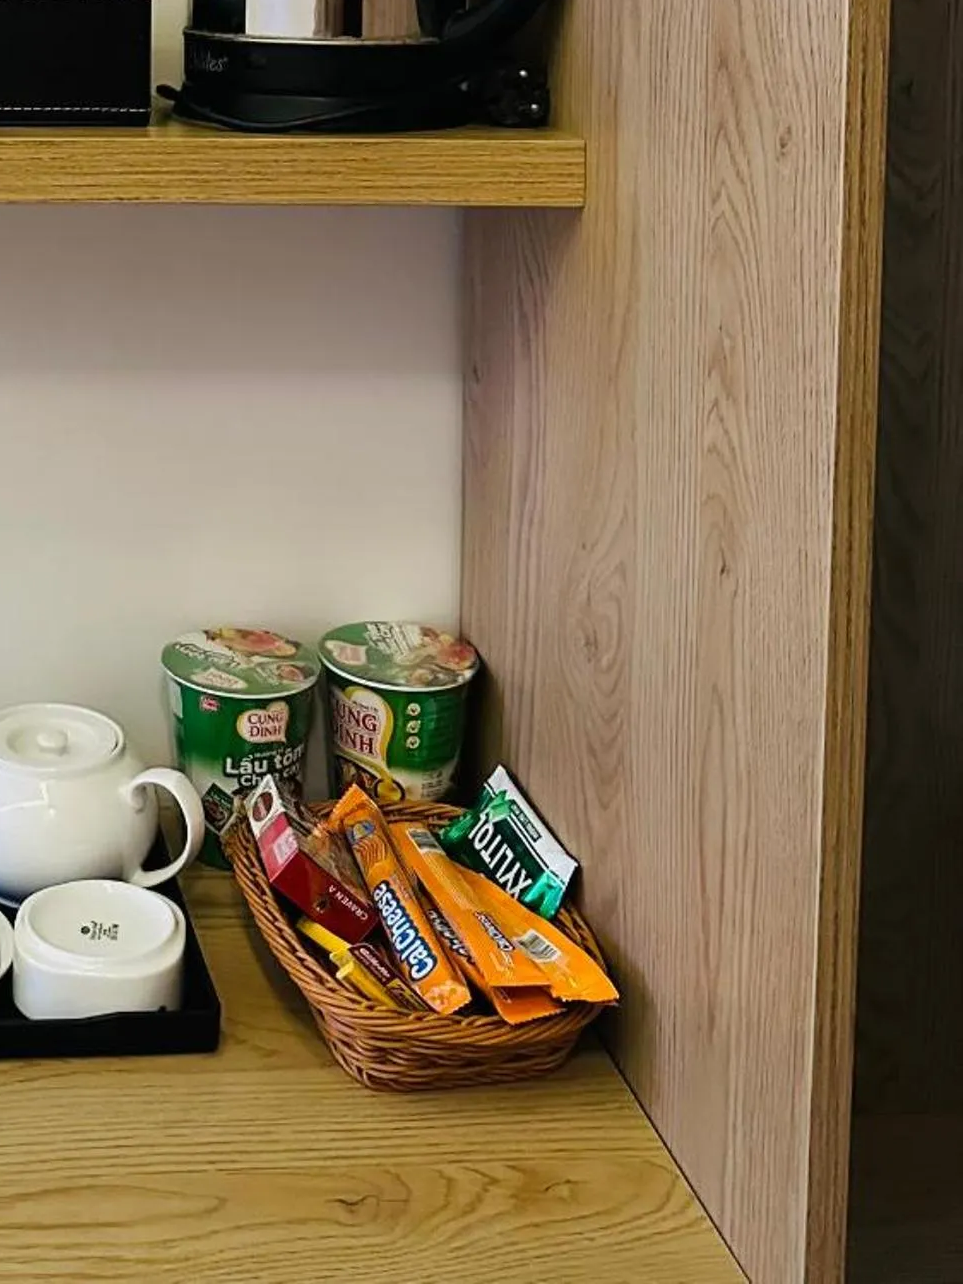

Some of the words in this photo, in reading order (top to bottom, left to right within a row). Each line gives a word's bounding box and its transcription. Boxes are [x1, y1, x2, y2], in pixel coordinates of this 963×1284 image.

[248, 713, 284, 725] CUNG
[334, 701, 377, 732] UNG
[468, 811, 532, 901] XYLITOL
[328, 884, 337, 893] A
[335, 891, 369, 921] CRAVEN
